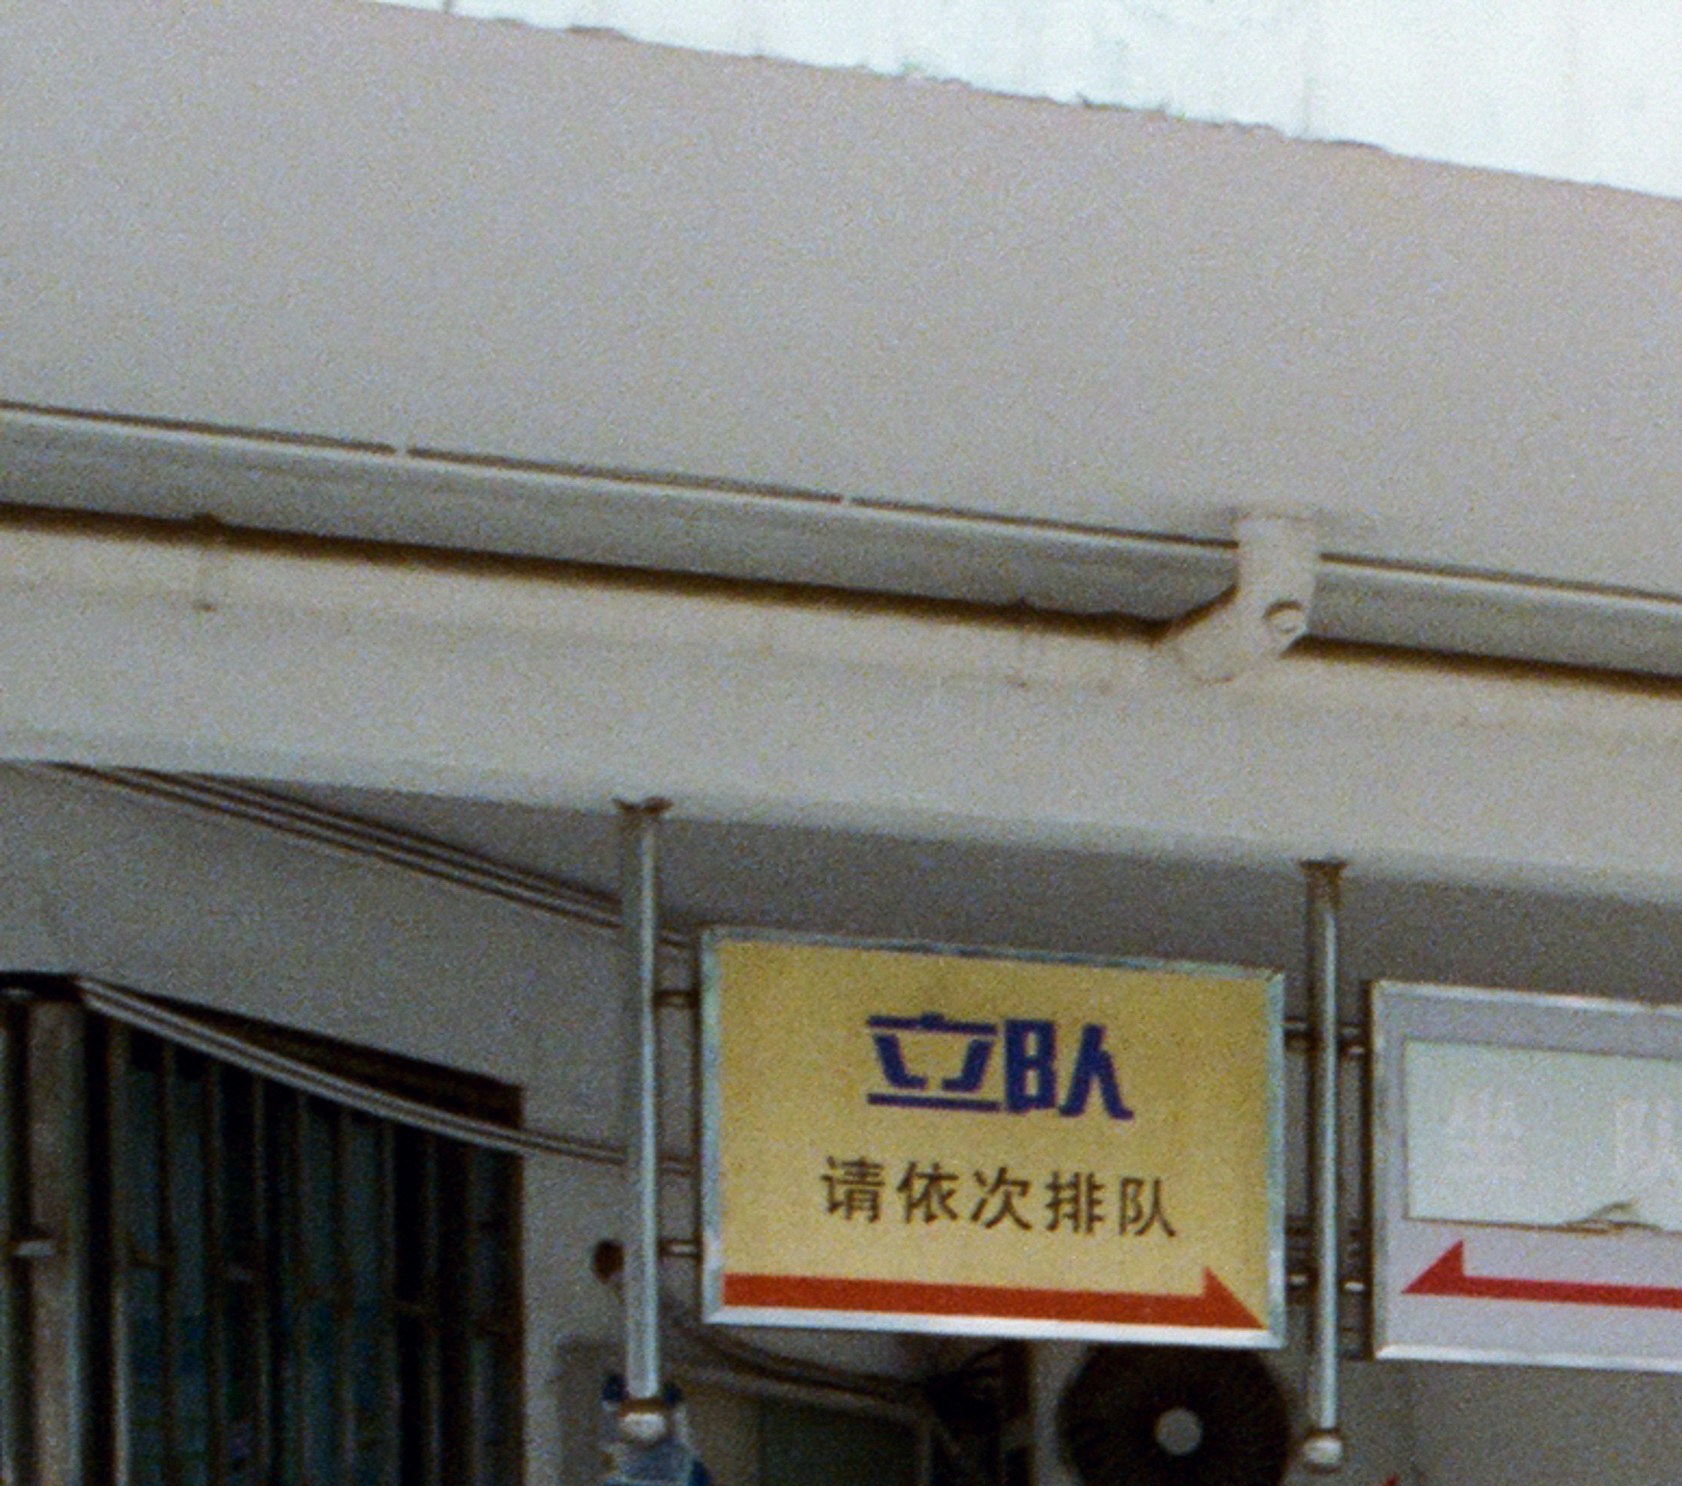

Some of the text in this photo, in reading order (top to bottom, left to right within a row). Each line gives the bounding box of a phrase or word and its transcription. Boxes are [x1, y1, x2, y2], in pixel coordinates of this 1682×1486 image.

[865, 1011, 1135, 1121] 立队
[820, 1156, 1178, 1238] 请依次排队
